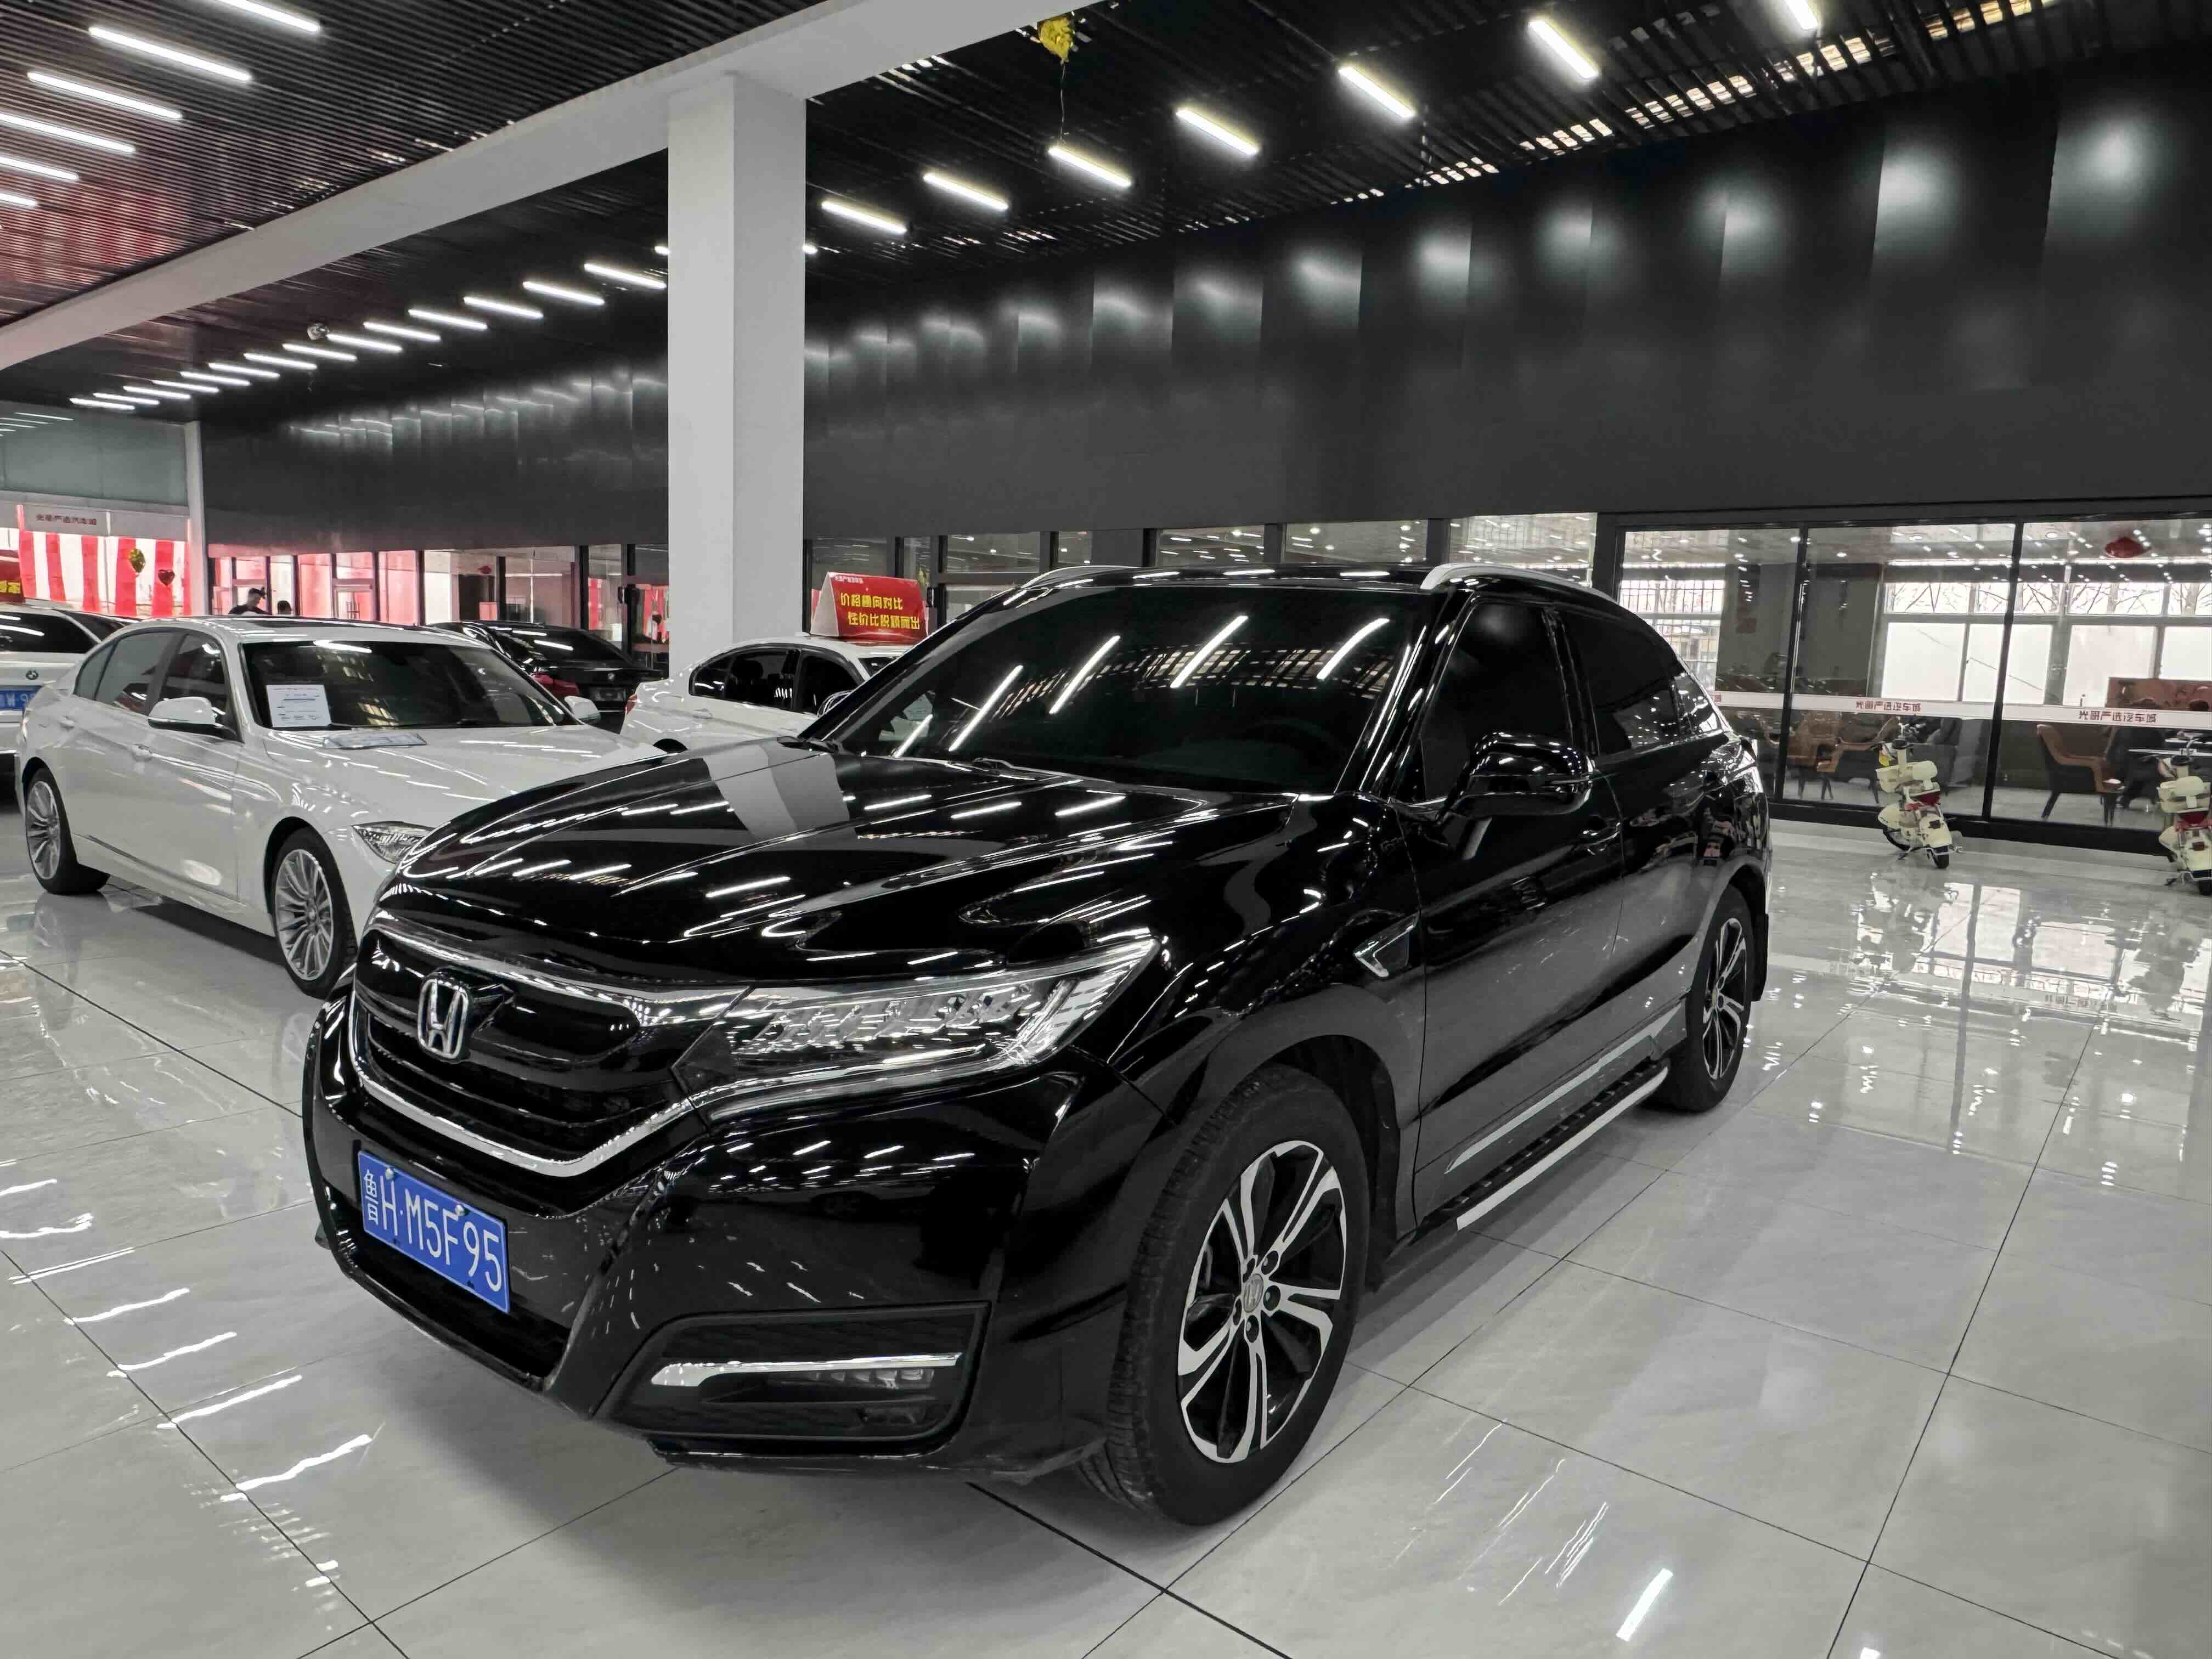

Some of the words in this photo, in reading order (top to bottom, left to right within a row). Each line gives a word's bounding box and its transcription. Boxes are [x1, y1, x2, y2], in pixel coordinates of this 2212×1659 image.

[840, 592, 903, 610] 价格横向对比
[848, 612, 919, 629] 性价比脱颖而出
